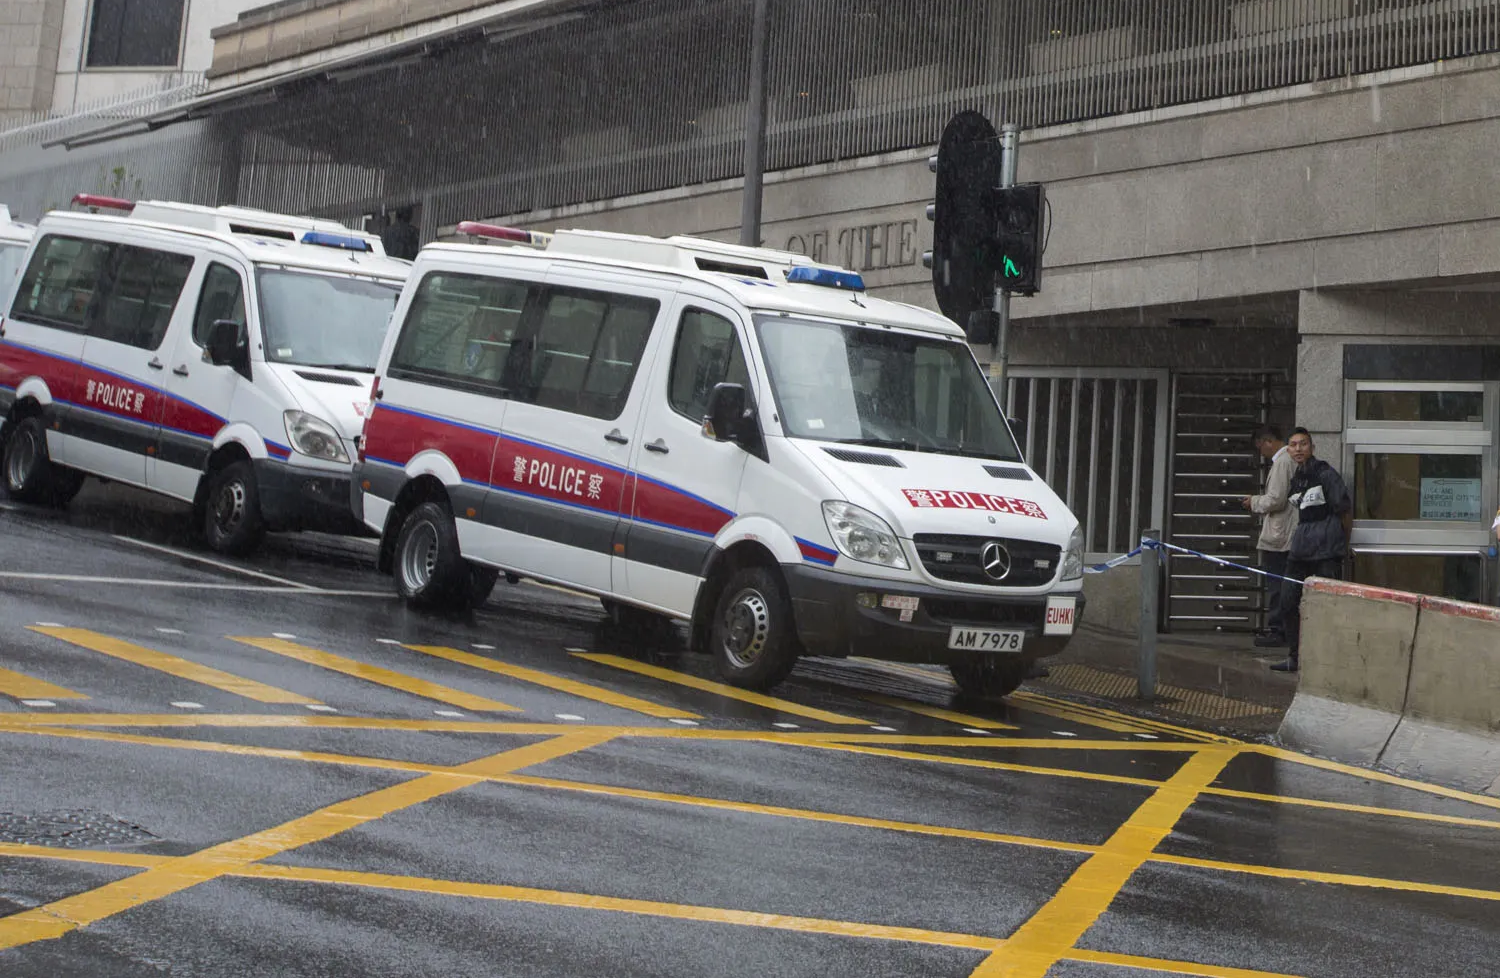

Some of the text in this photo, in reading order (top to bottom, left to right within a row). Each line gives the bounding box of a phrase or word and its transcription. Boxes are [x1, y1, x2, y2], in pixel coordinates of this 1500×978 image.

[838, 219, 918, 272] THE
[96, 382, 134, 411] POLICE
[528, 459, 586, 496] POLICE
[587, 473, 604, 500] 察
[928, 490, 1026, 515] POLICE
[954, 630, 1020, 649] AM 7978
